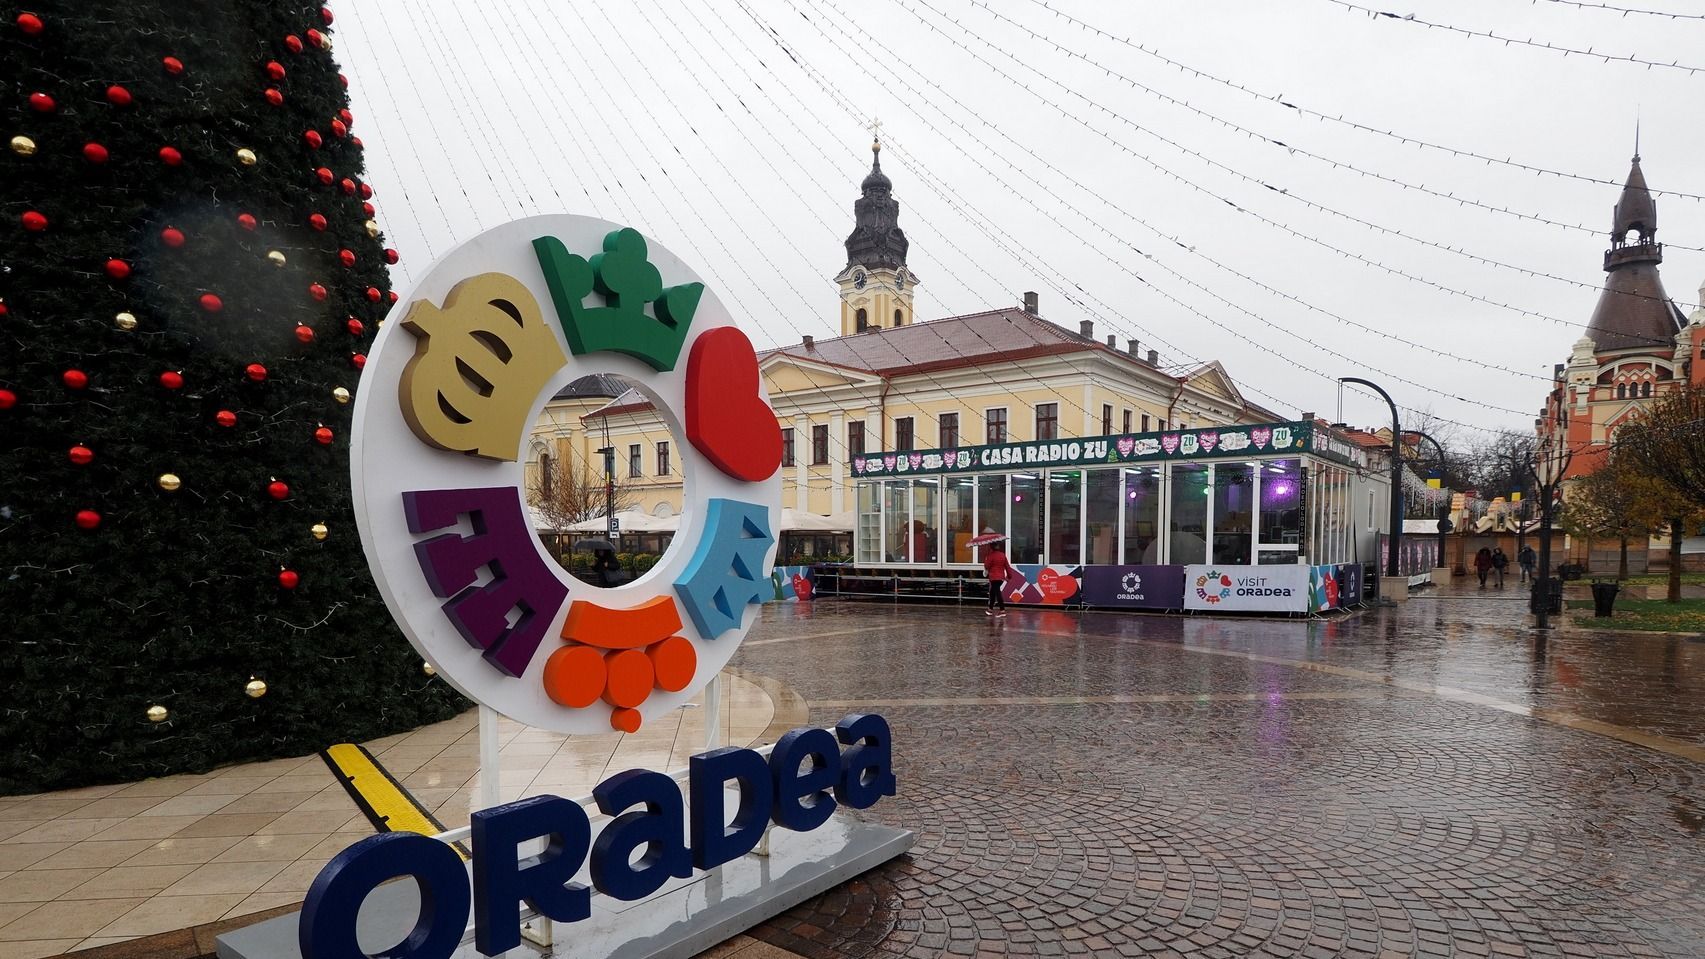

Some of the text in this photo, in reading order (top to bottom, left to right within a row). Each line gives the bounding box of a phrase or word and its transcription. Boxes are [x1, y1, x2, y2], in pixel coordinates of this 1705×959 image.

[1275, 430, 1288, 440] ZU
[1183, 436, 1194, 446] ZU
[981, 446, 1022, 466] CASA
[1025, 441, 1081, 463] RADIO
[1083, 440, 1108, 459] ZU
